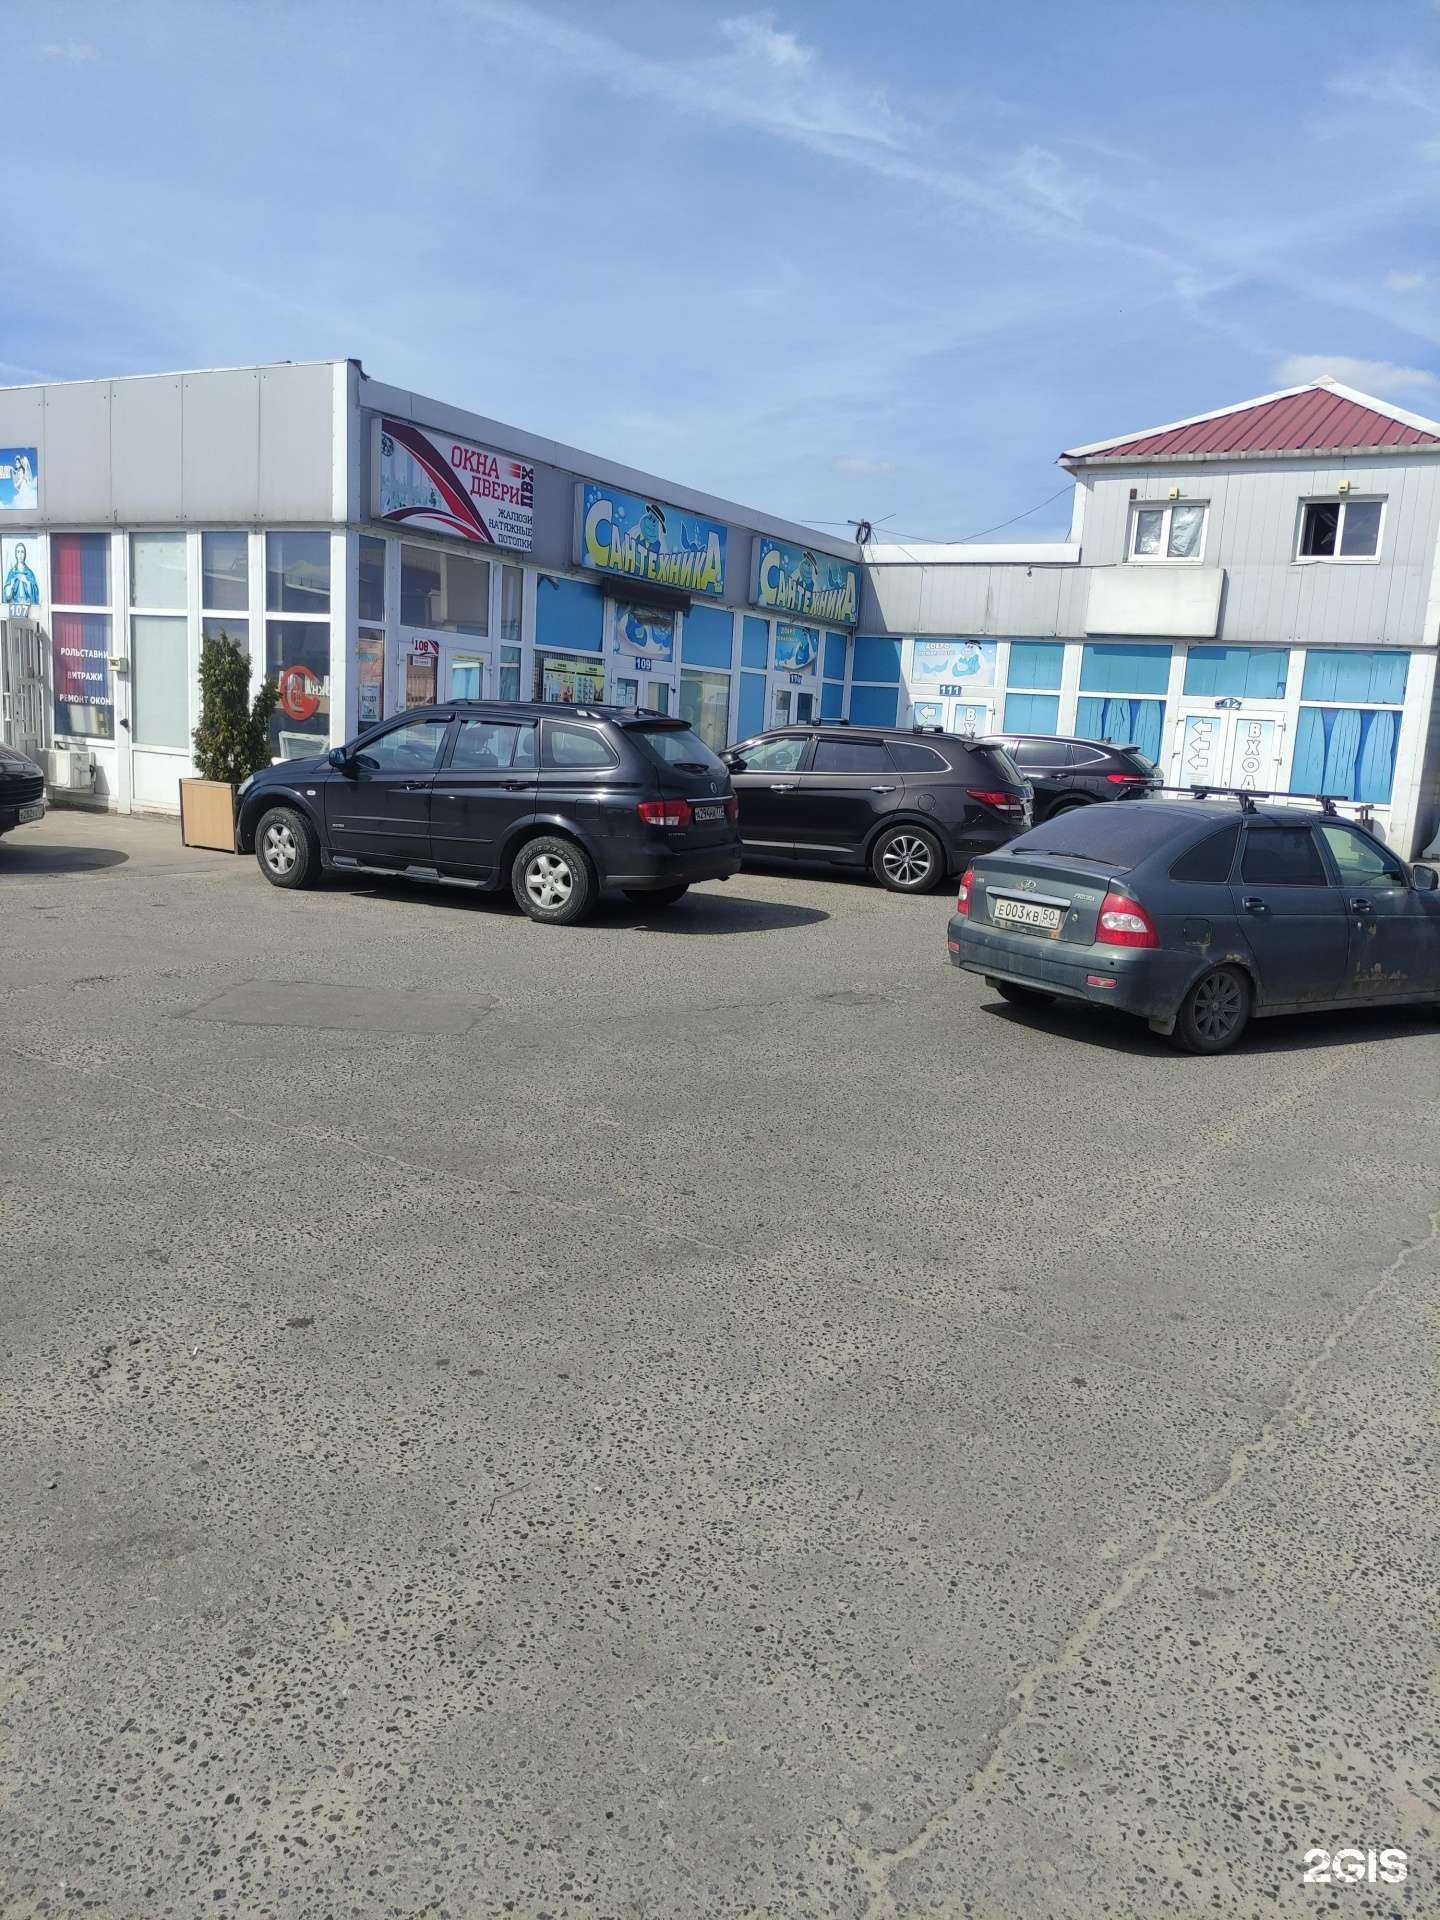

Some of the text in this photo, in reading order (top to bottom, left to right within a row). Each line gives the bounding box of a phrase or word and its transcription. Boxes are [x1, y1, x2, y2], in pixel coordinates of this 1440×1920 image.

[451, 445, 500, 480] ОКНА
[470, 475, 520, 505] ДВЕРИ
[520, 465, 534, 509] ПВХ
[488, 518, 533, 537] НАТЯЖНЫЕ
[498, 533, 533, 550] ПОТОЛКИ
[585, 499, 723, 593] САНТЕХНИКА
[759, 550, 857, 623] САНТЕХНИКА
[9, 605, 29, 617] 107
[60, 647, 108, 658] РОЛЬСТАВНИ
[415, 639, 429, 652] 108
[637, 657, 651, 670] 109
[67, 671, 103, 681] ВИТРАЖИ
[940, 685, 961, 696] 111
[59, 693, 112, 705] РЕМОНТ ОКОН
